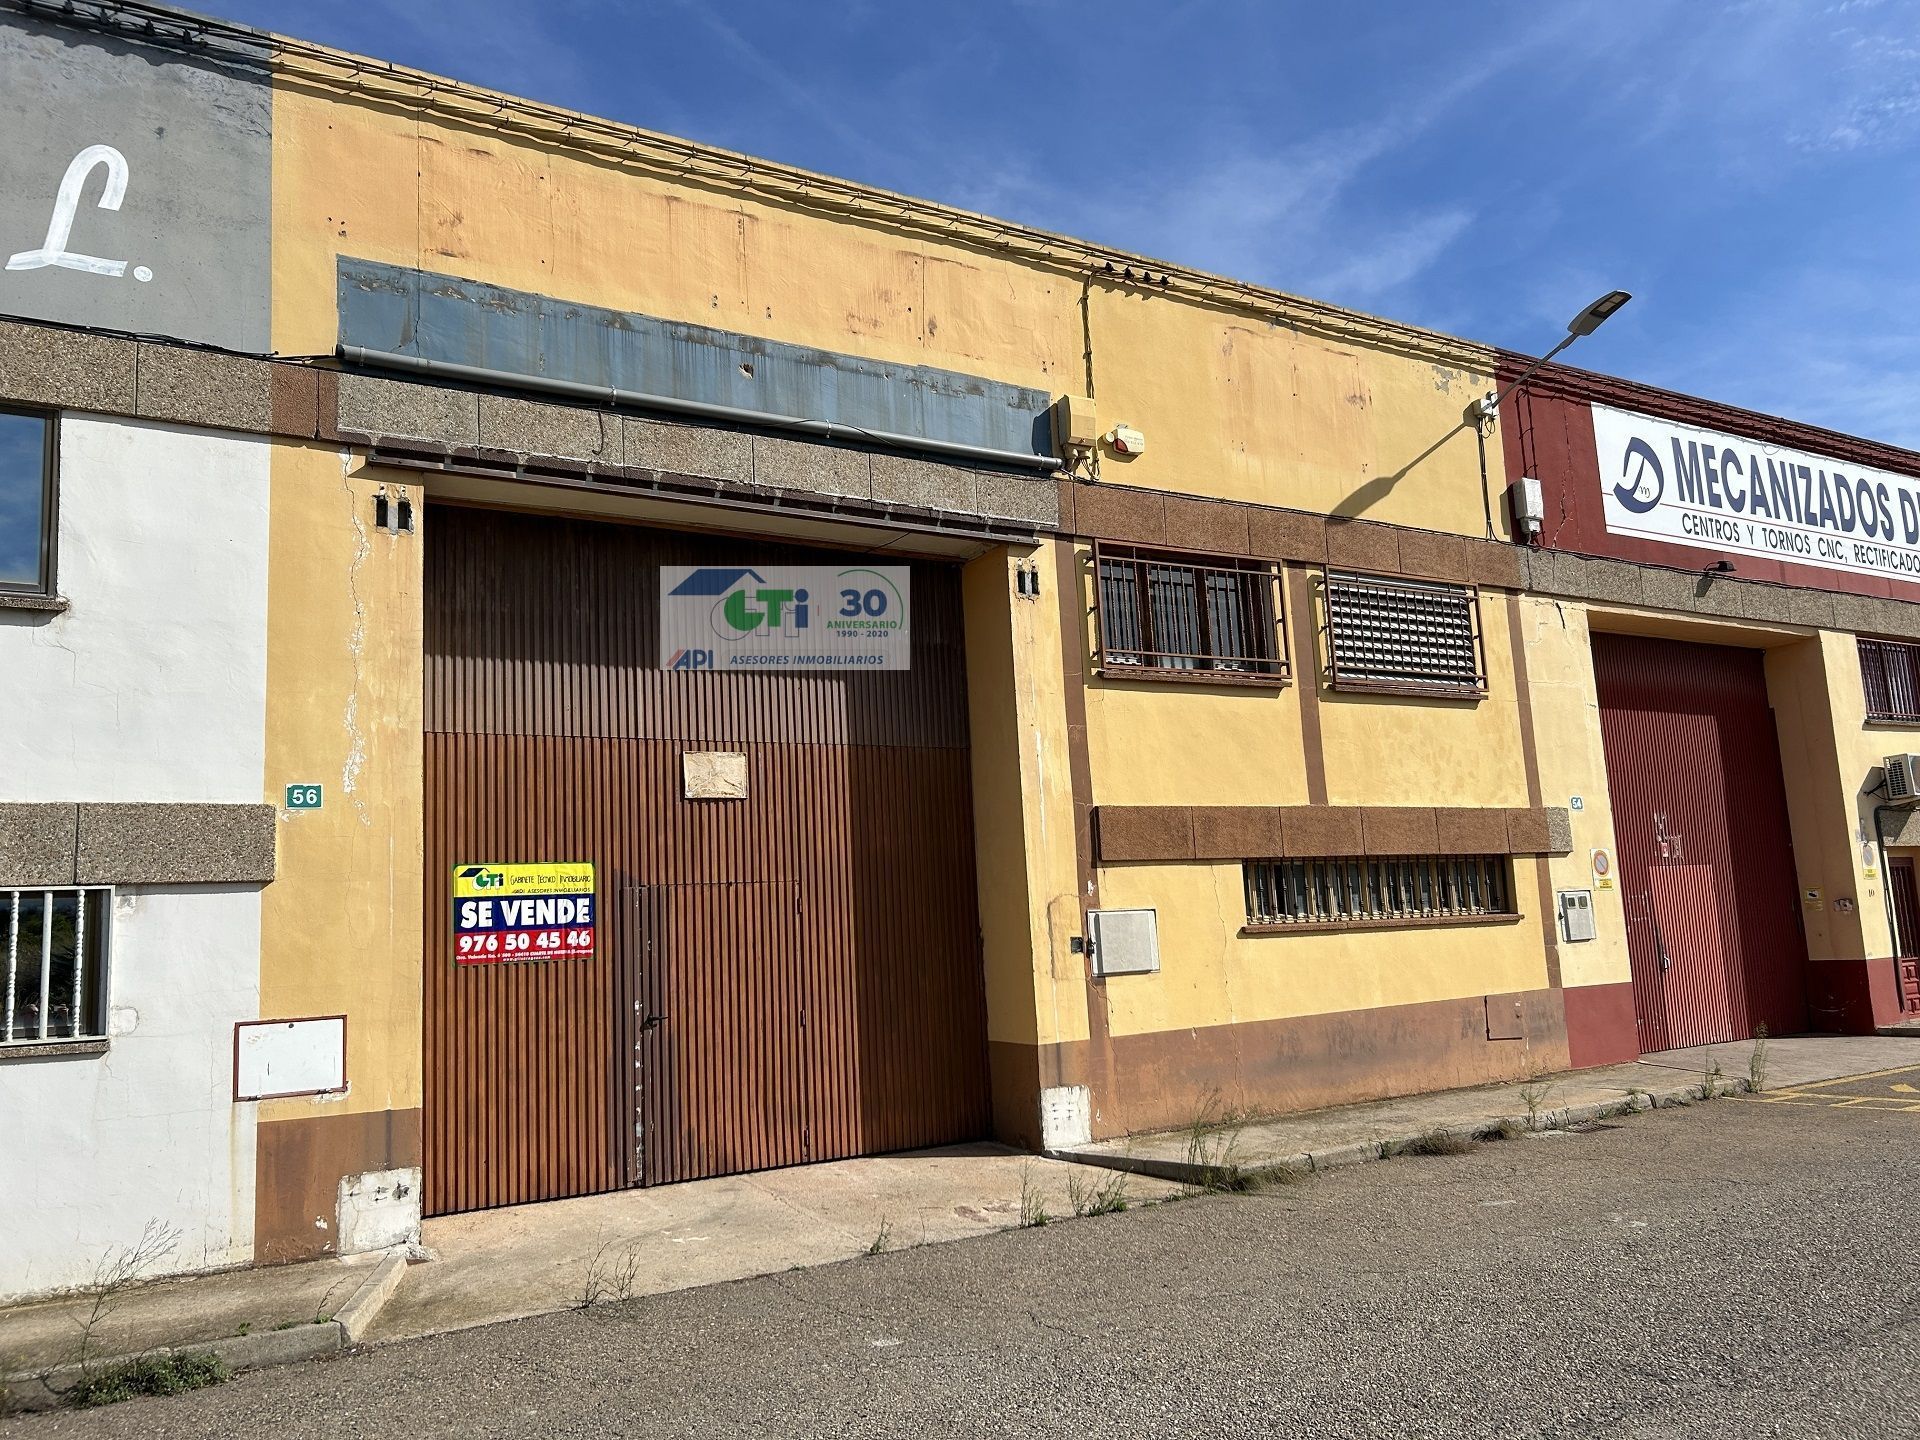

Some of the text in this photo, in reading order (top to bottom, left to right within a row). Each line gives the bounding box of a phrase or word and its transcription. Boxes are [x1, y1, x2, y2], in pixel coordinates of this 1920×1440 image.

[1671, 436, 1920, 545] MECANIZADOS D
[1682, 512, 1740, 543] CENTROS
[1746, 524, 1754, 545] Y
[1762, 528, 1811, 554] TORNOS
[1817, 537, 1848, 563] CNC,
[291, 788, 318, 805] 56
[460, 898, 591, 929] SE VENDE
[459, 930, 591, 953] 976 50 45 46
